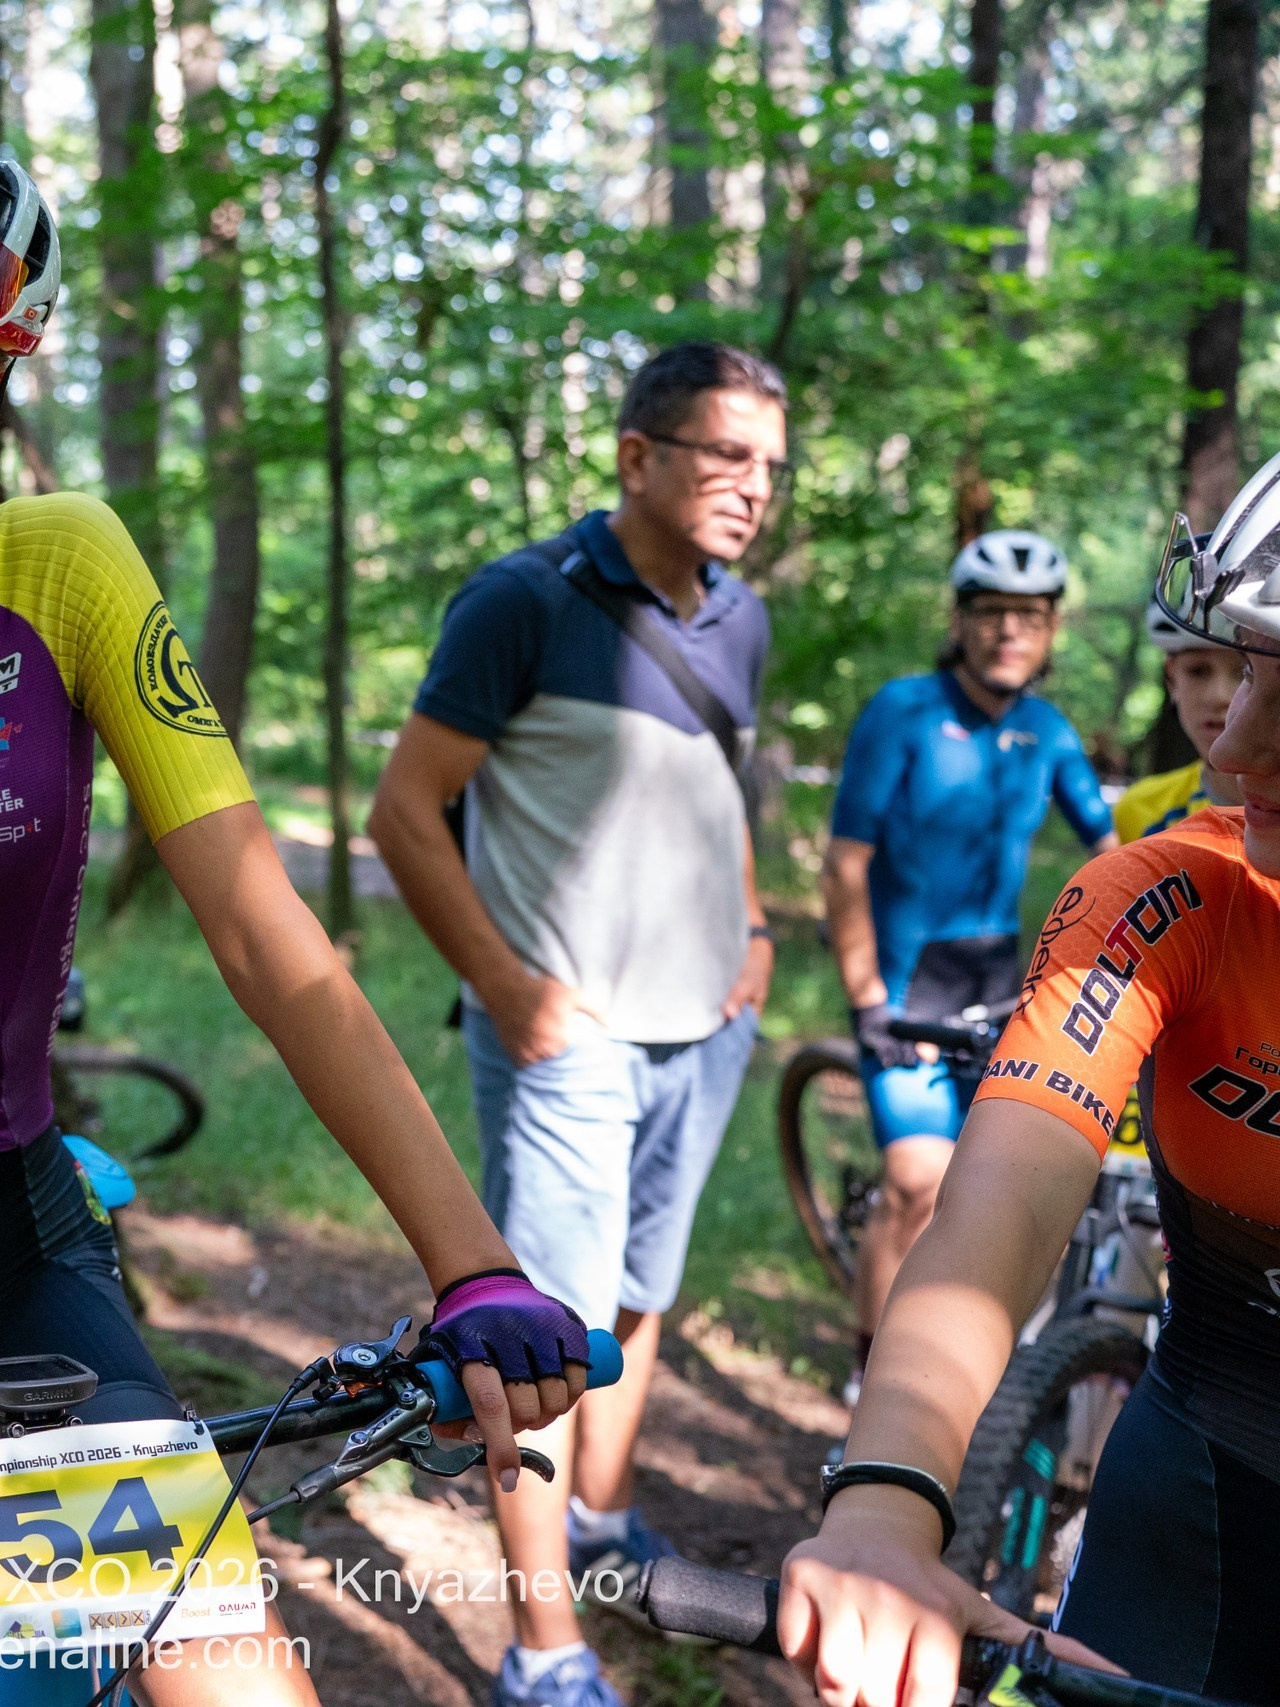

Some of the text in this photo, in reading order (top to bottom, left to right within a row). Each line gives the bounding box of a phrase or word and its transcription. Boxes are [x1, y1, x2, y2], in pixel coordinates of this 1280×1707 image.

[146, 614, 169, 692] КОЛОЕЗДАЧЕ
[1061, 869, 1204, 1056] DOLTON
[1234, 1046, 1280, 1076] Гор
[1045, 1069, 1116, 1140] BIKE
[23, 1388, 74, 1402] GARMIN
[59, 1451, 85, 1466] XCO
[88, 1447, 122, 1461] 2026
[132, 1440, 199, 1457] Knyazhevo
